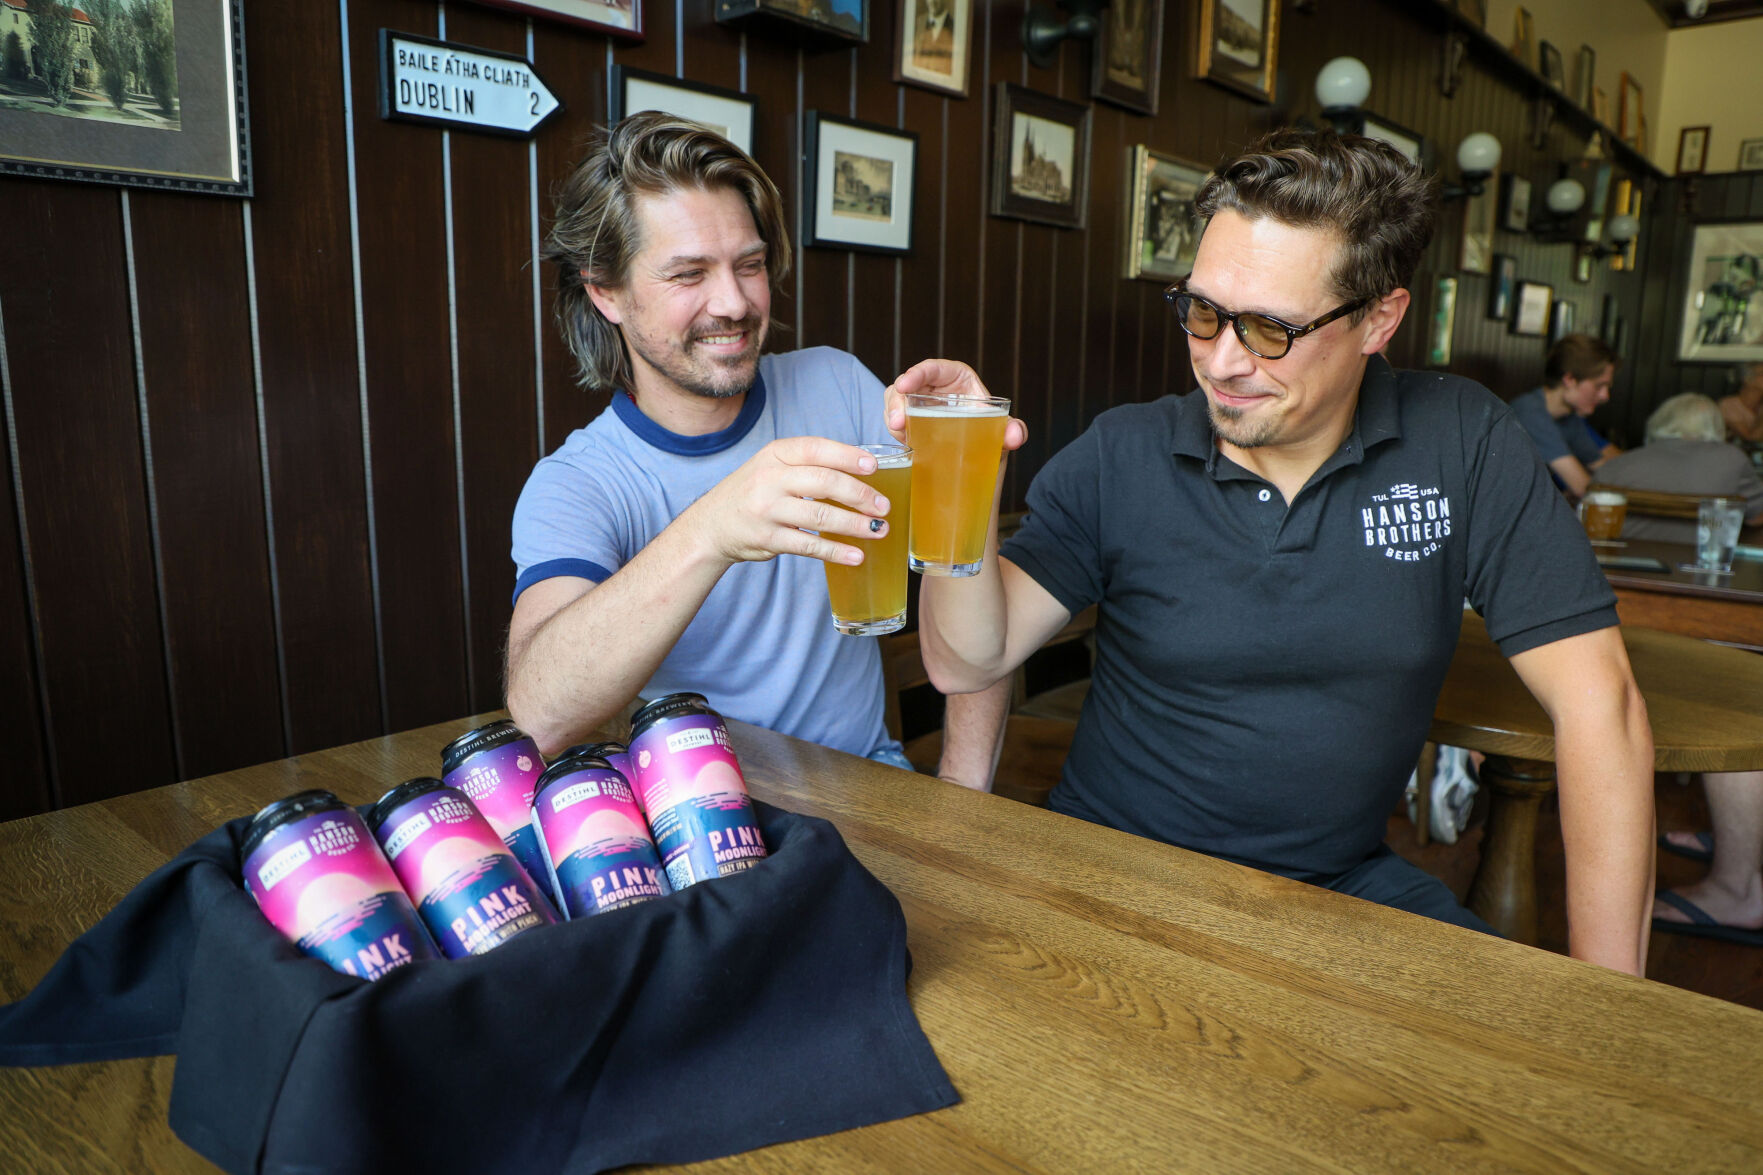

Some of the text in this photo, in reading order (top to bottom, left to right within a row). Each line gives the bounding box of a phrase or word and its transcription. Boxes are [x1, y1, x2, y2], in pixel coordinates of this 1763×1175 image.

[398, 49, 530, 88] BAILE ÁTHA CLIATH
[400, 79, 540, 116] DUBLIN 2
[1372, 487, 1440, 502] TUL USA
[1361, 497, 1450, 528] HANSON
[1365, 519, 1451, 546] BROTHERS
[1385, 542, 1442, 561] BEER CO.
[455, 740, 485, 758] DESTIHL
[669, 734, 711, 748] DESTIHL
[555, 786, 596, 807] DESTIHL
[708, 826, 766, 852] PINK
[591, 867, 661, 898] PINK
[596, 885, 664, 908] MOONLIGHT
[451, 885, 528, 941] PINK
[463, 902, 532, 953] MOONLIGHT
[343, 933, 409, 977] INK
